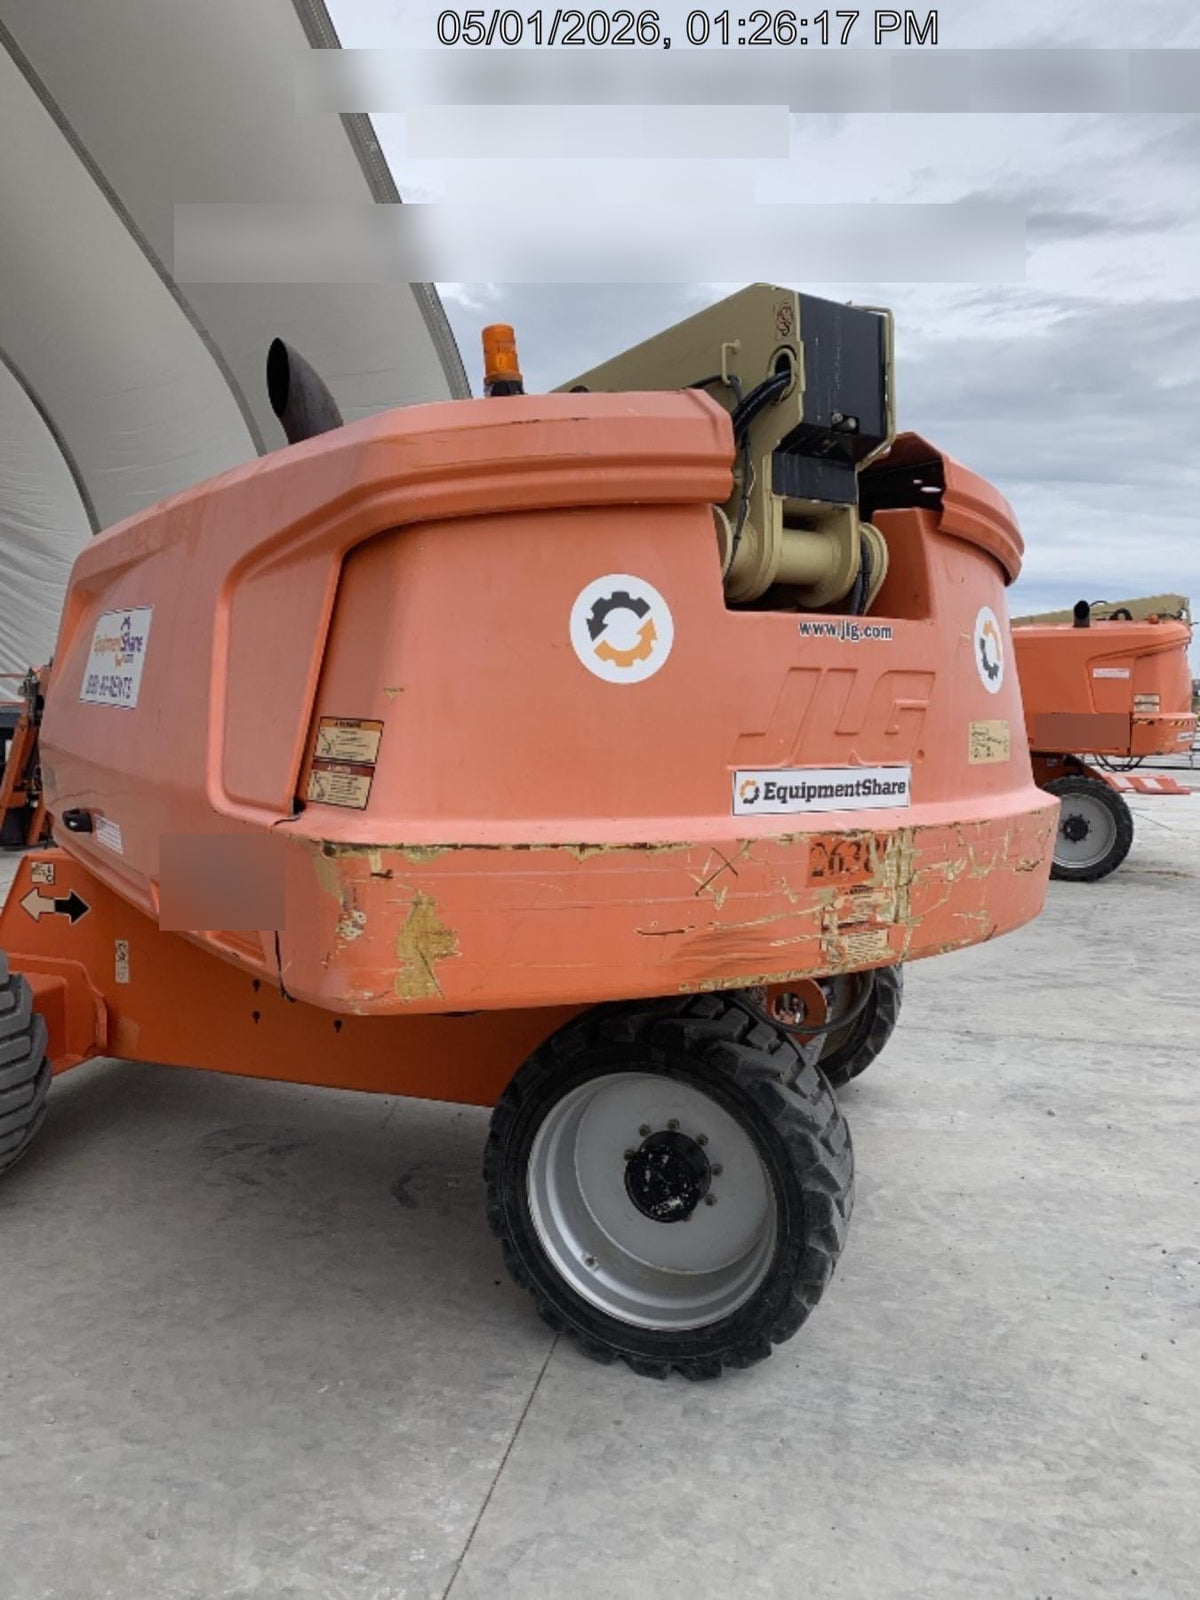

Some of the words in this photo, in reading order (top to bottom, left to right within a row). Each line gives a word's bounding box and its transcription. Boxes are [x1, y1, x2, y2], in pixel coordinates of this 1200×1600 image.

[799, 621, 893, 641] www.jlg.com
[726, 666, 936, 769] JLG
[763, 778, 907, 803] EquipmentShare
